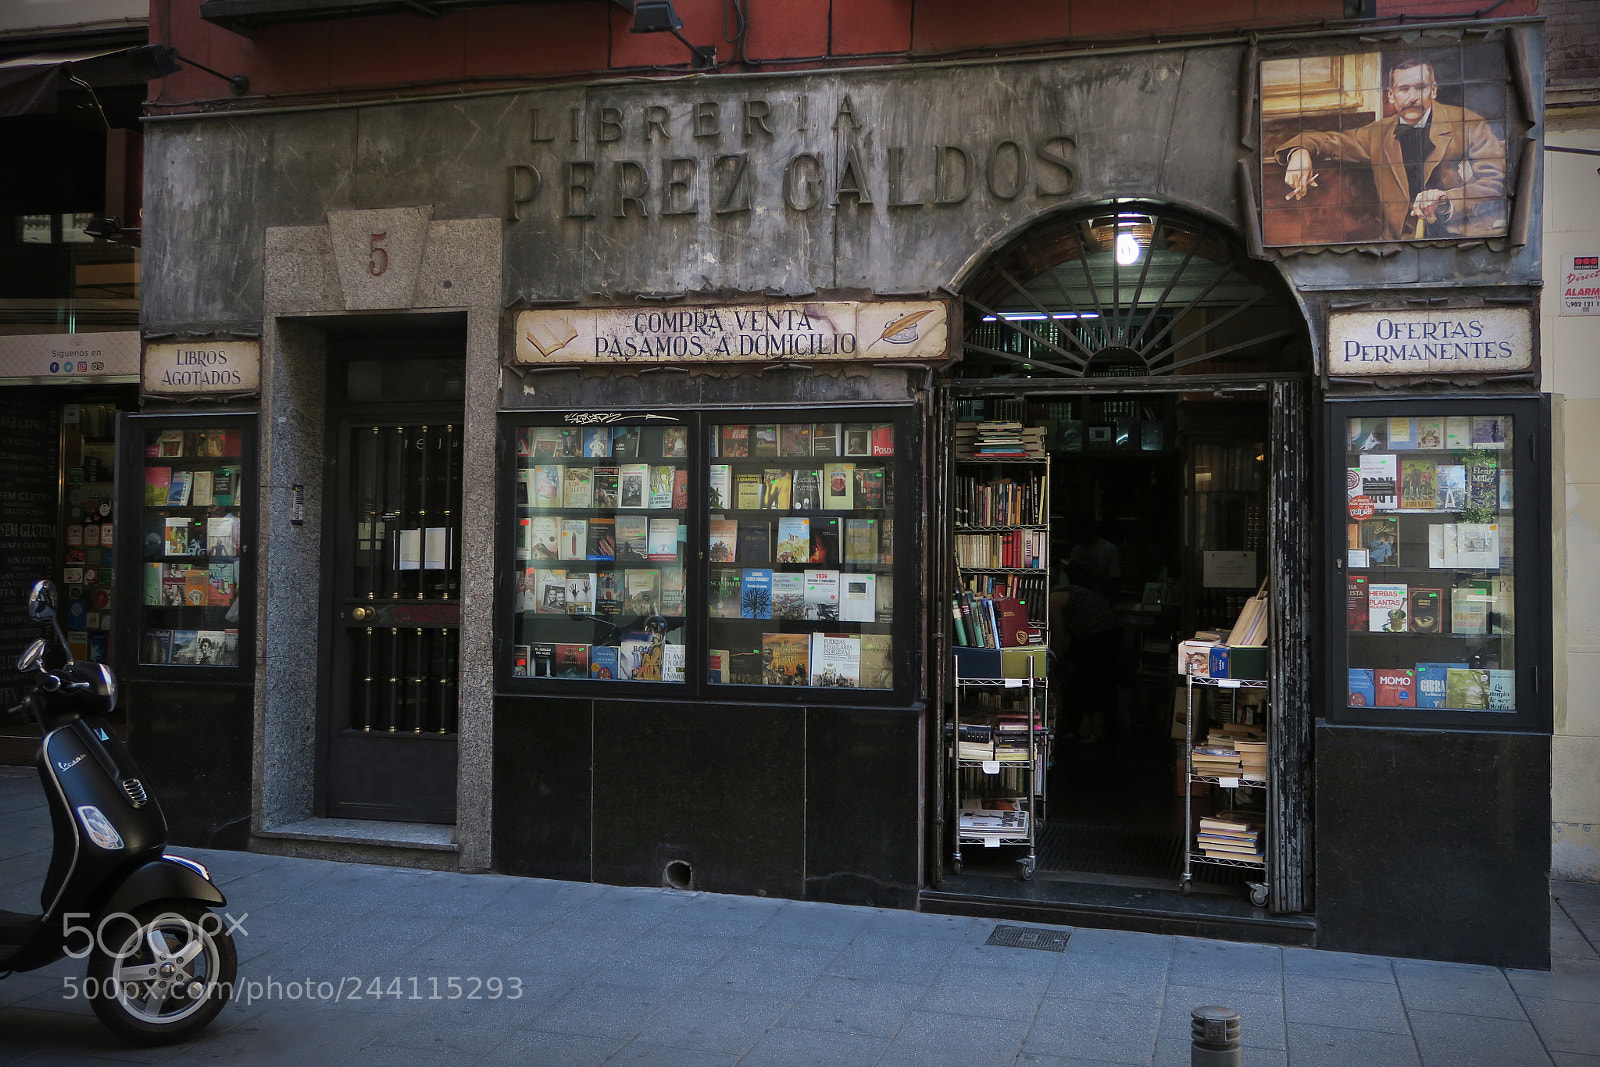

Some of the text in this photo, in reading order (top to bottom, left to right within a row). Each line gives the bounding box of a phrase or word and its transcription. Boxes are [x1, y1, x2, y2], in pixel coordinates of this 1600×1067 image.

[530, 95, 862, 142] LIBRERIA
[507, 136, 1081, 221] PEREZ GALDOS
[367, 231, 389, 277] 5
[635, 308, 814, 336] COMPRA VENTA
[595, 332, 857, 358] PASAMOS A DOMICILIO
[1380, 676, 1411, 686] MOMO
